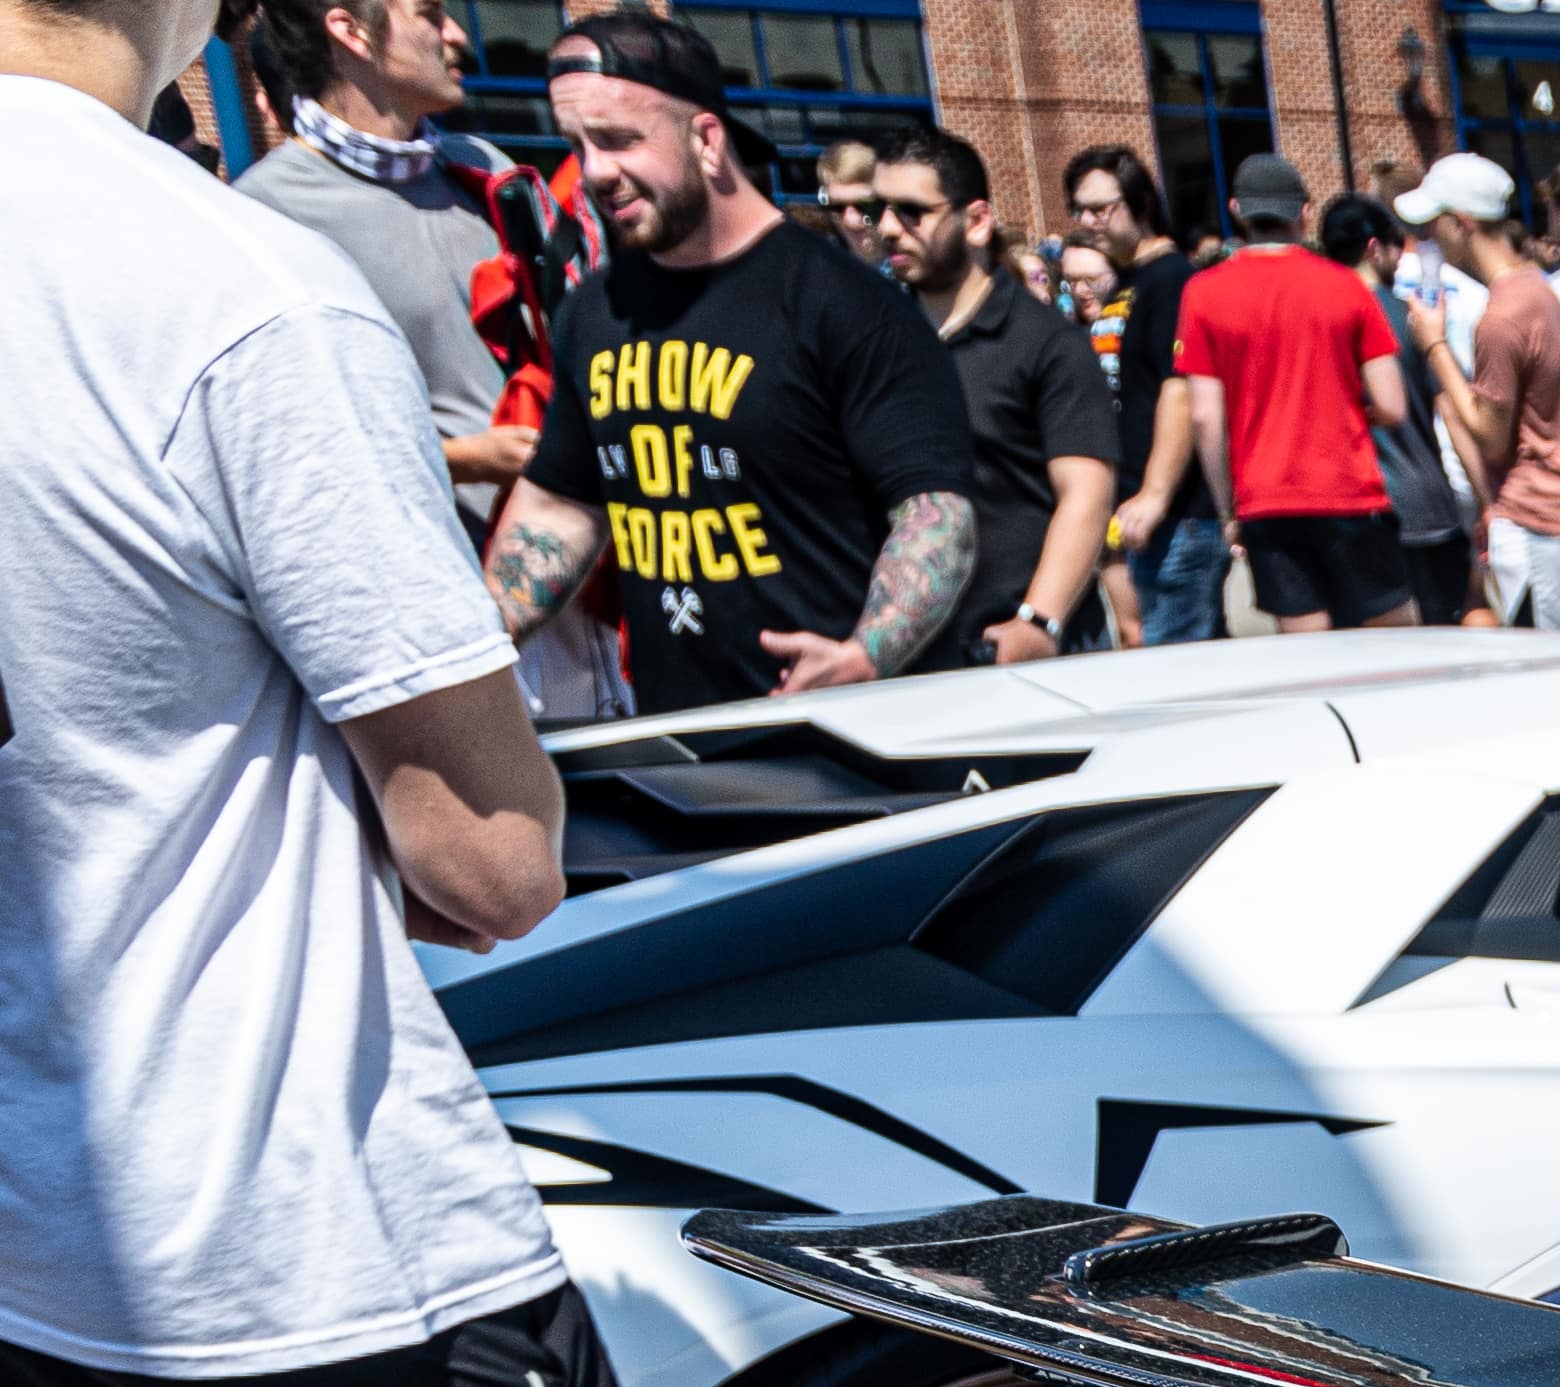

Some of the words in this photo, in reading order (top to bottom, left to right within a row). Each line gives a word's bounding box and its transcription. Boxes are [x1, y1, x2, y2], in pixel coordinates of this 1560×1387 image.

[590, 340, 755, 421] SHOW
[630, 424, 694, 499] OF
[607, 502, 782, 582] FORCE
